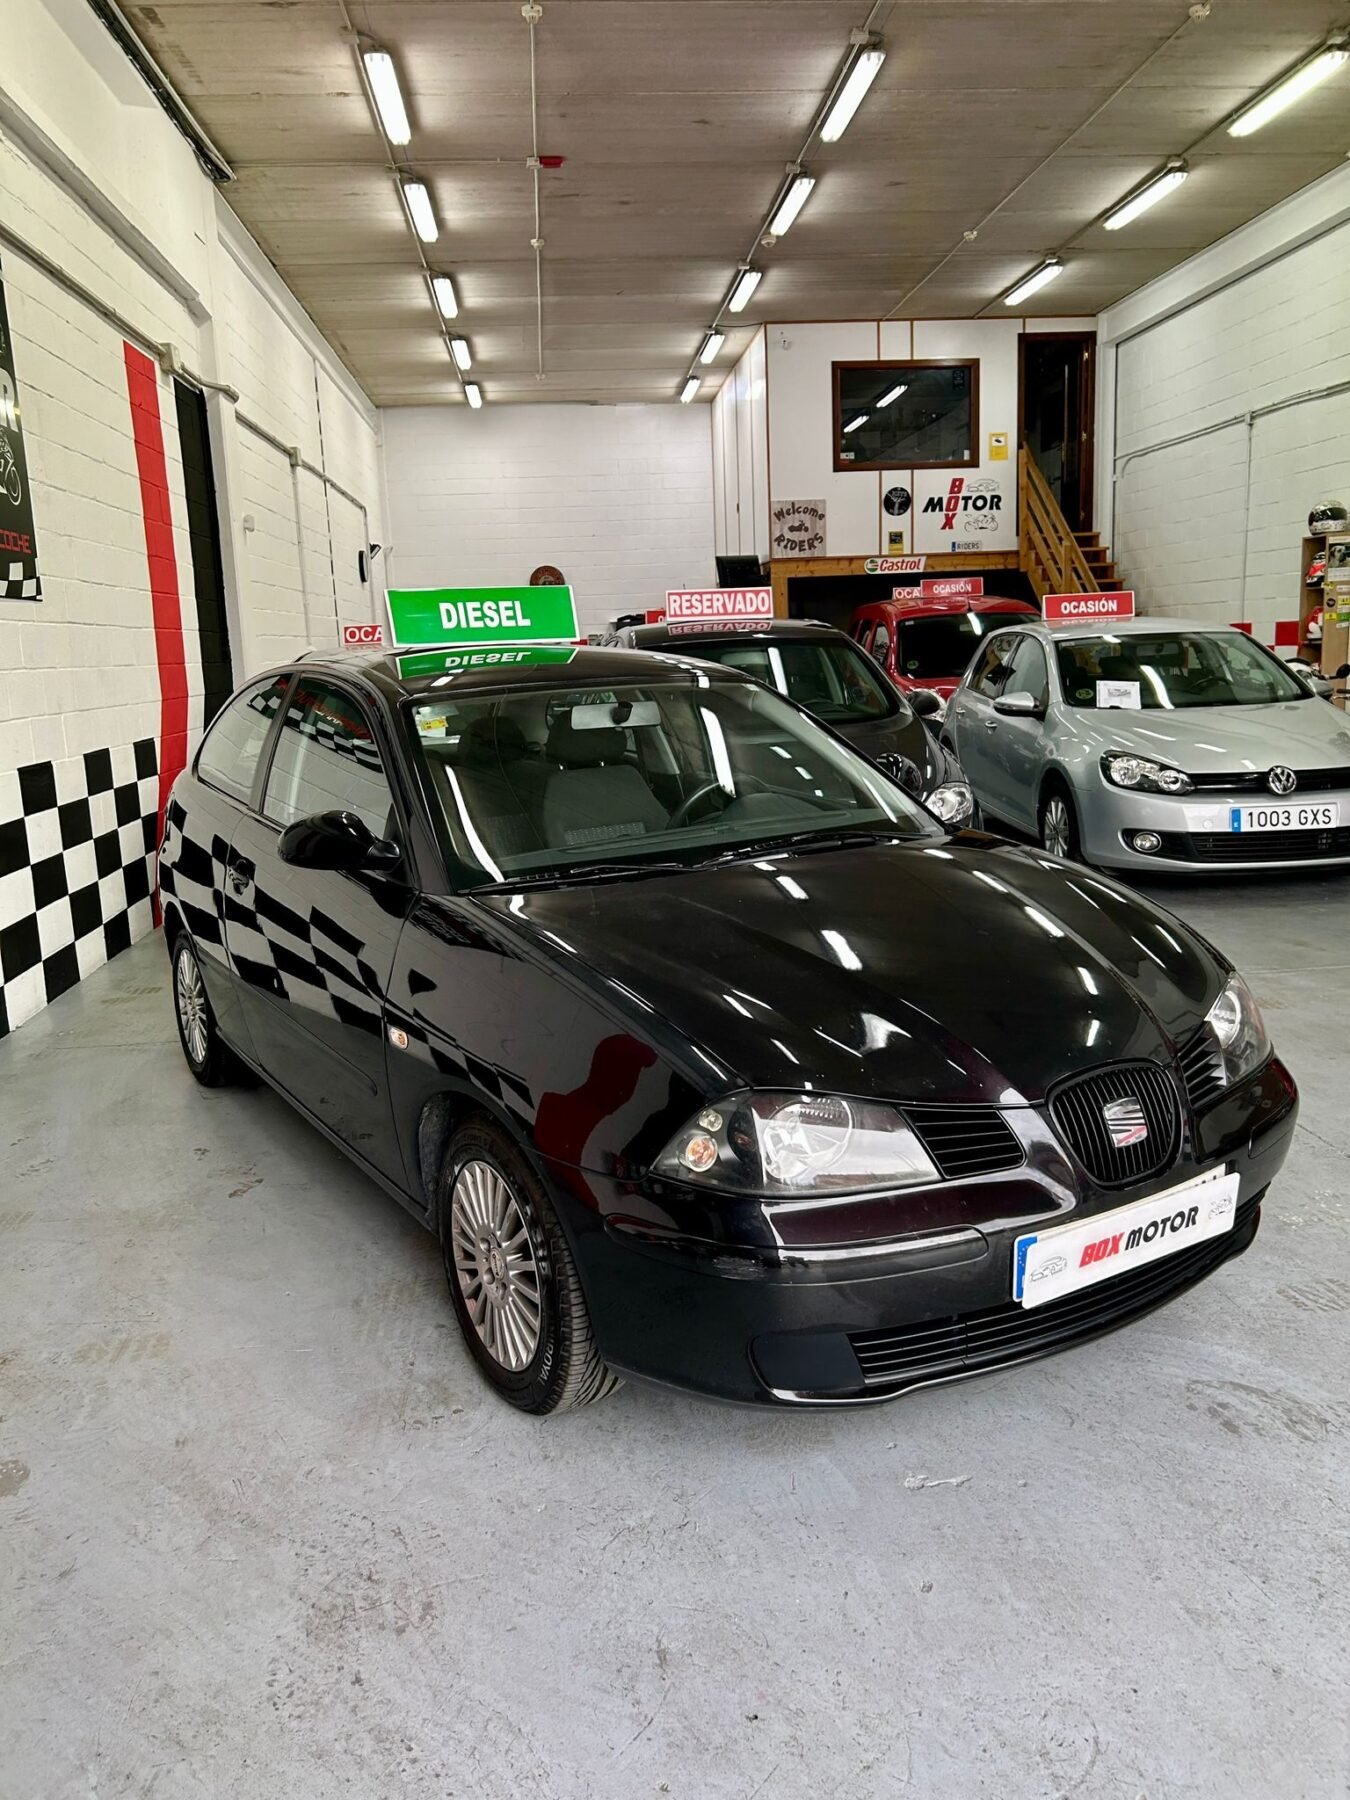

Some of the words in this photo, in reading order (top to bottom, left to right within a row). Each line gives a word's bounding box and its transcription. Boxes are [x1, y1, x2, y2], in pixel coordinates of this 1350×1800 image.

[773, 501, 825, 521] Welcome
[774, 532, 823, 552] RIDERS
[957, 542, 980, 550] RIDERS
[880, 558, 921, 572] Castrol
[933, 583, 972, 594] OCASIÓN
[669, 591, 770, 616] RESERVADO
[1060, 597, 1118, 614] OCASIÓN
[439, 600, 531, 629] DIESEL
[1248, 810, 1291, 828] 1003
[1298, 808, 1332, 826] GXS
[1079, 1231, 1125, 1268] BOX
[1124, 1205, 1200, 1251] MOTOR
